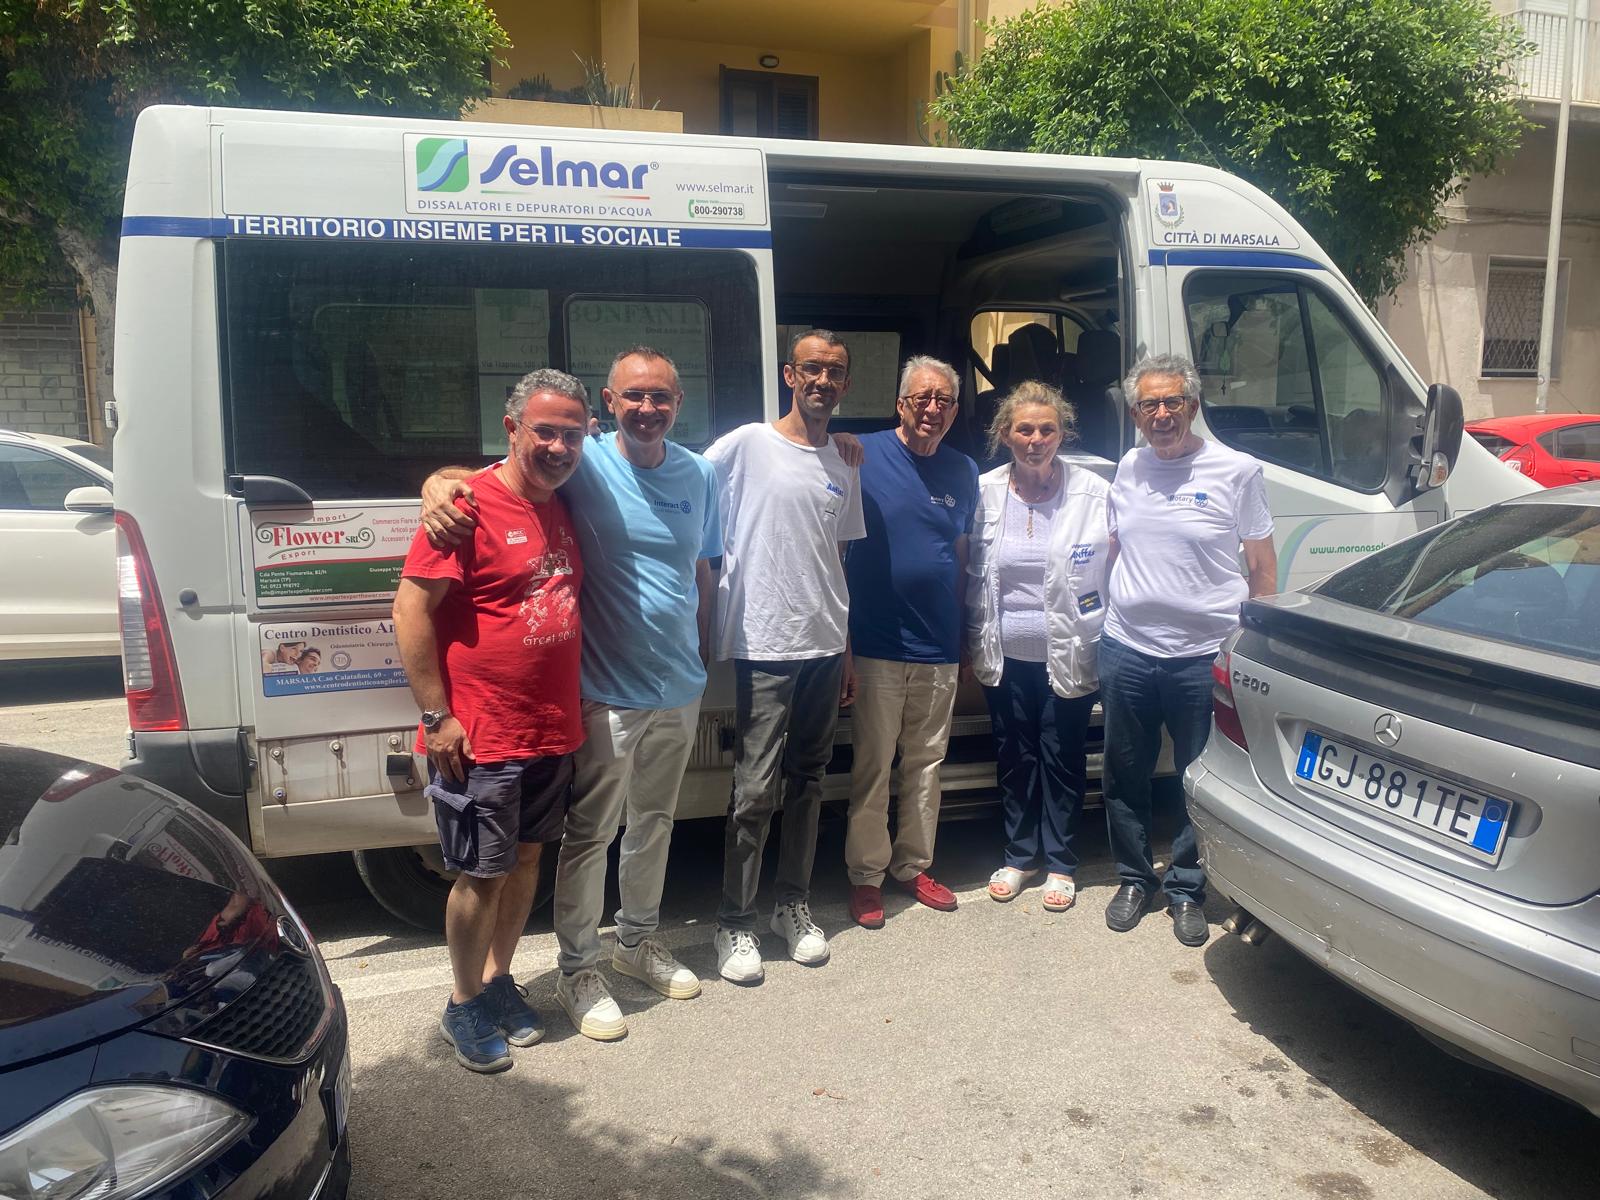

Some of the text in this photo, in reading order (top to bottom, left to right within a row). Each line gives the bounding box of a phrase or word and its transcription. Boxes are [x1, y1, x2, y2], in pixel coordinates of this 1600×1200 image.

[480, 144, 649, 190] Selmar
[675, 182, 754, 194] www.selmar.it
[417, 199, 653, 217] DISSALATORI E DEPURATORI D'ACQUA
[694, 205, 744, 216] 800-290738
[228, 215, 682, 247] TERRITORIO INSIEME PER IL SOCIALE
[1164, 230, 1280, 246] CITTÀ DI MARSALA
[312, 513, 347, 523] Import
[273, 527, 360, 547] Flower SRL
[281, 549, 316, 561] Export
[264, 627, 308, 641] Centro
[311, 624, 372, 638] Dentistico
[276, 676, 317, 686] MARSALA
